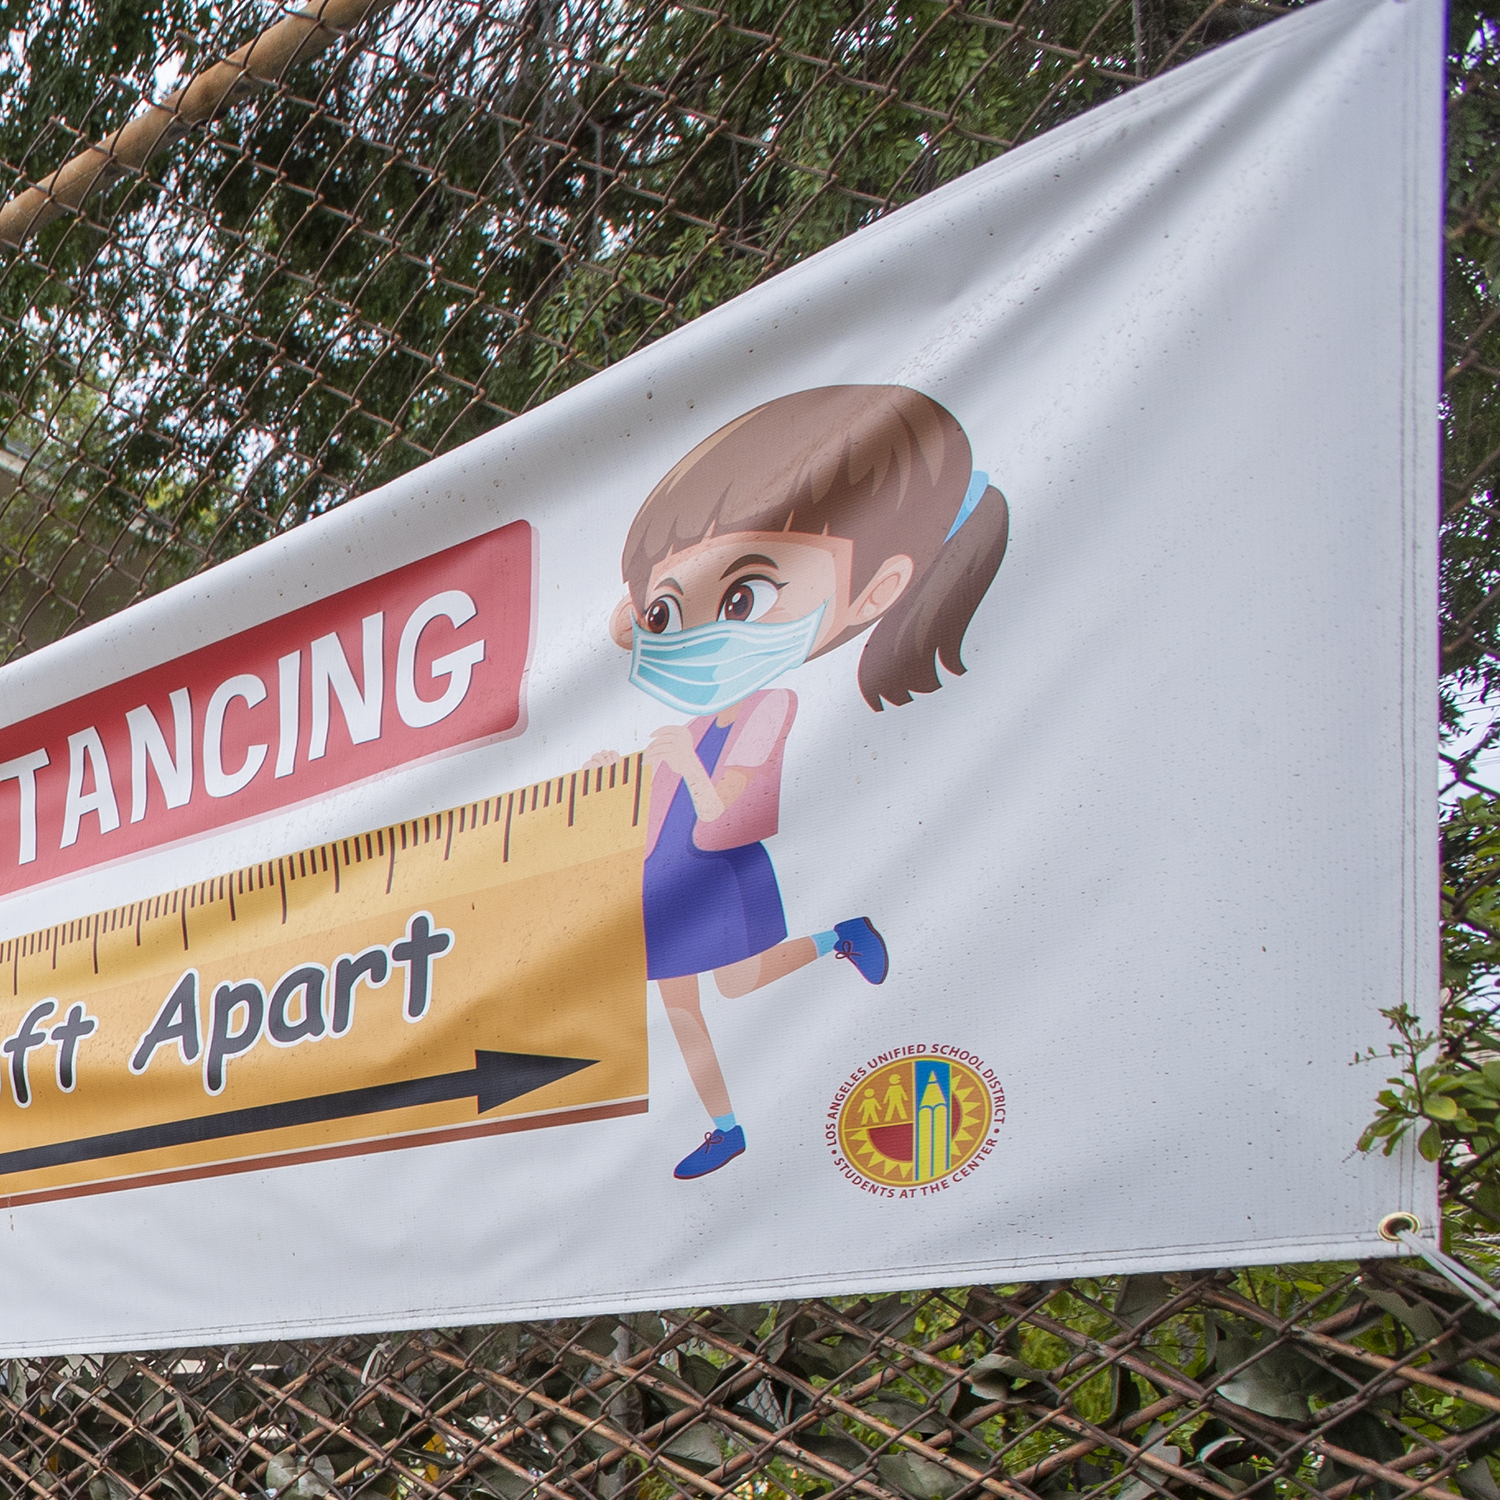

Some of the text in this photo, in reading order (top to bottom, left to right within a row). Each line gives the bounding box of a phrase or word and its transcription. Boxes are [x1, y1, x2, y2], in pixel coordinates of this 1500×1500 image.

[129, 912, 455, 1095] Apart
[825, 1043, 1007, 1147] LOS ANGELES UNIFIED SCHOOL DISTRICT
[833, 1137, 999, 1199] STUDENTS AT THE CENTER
